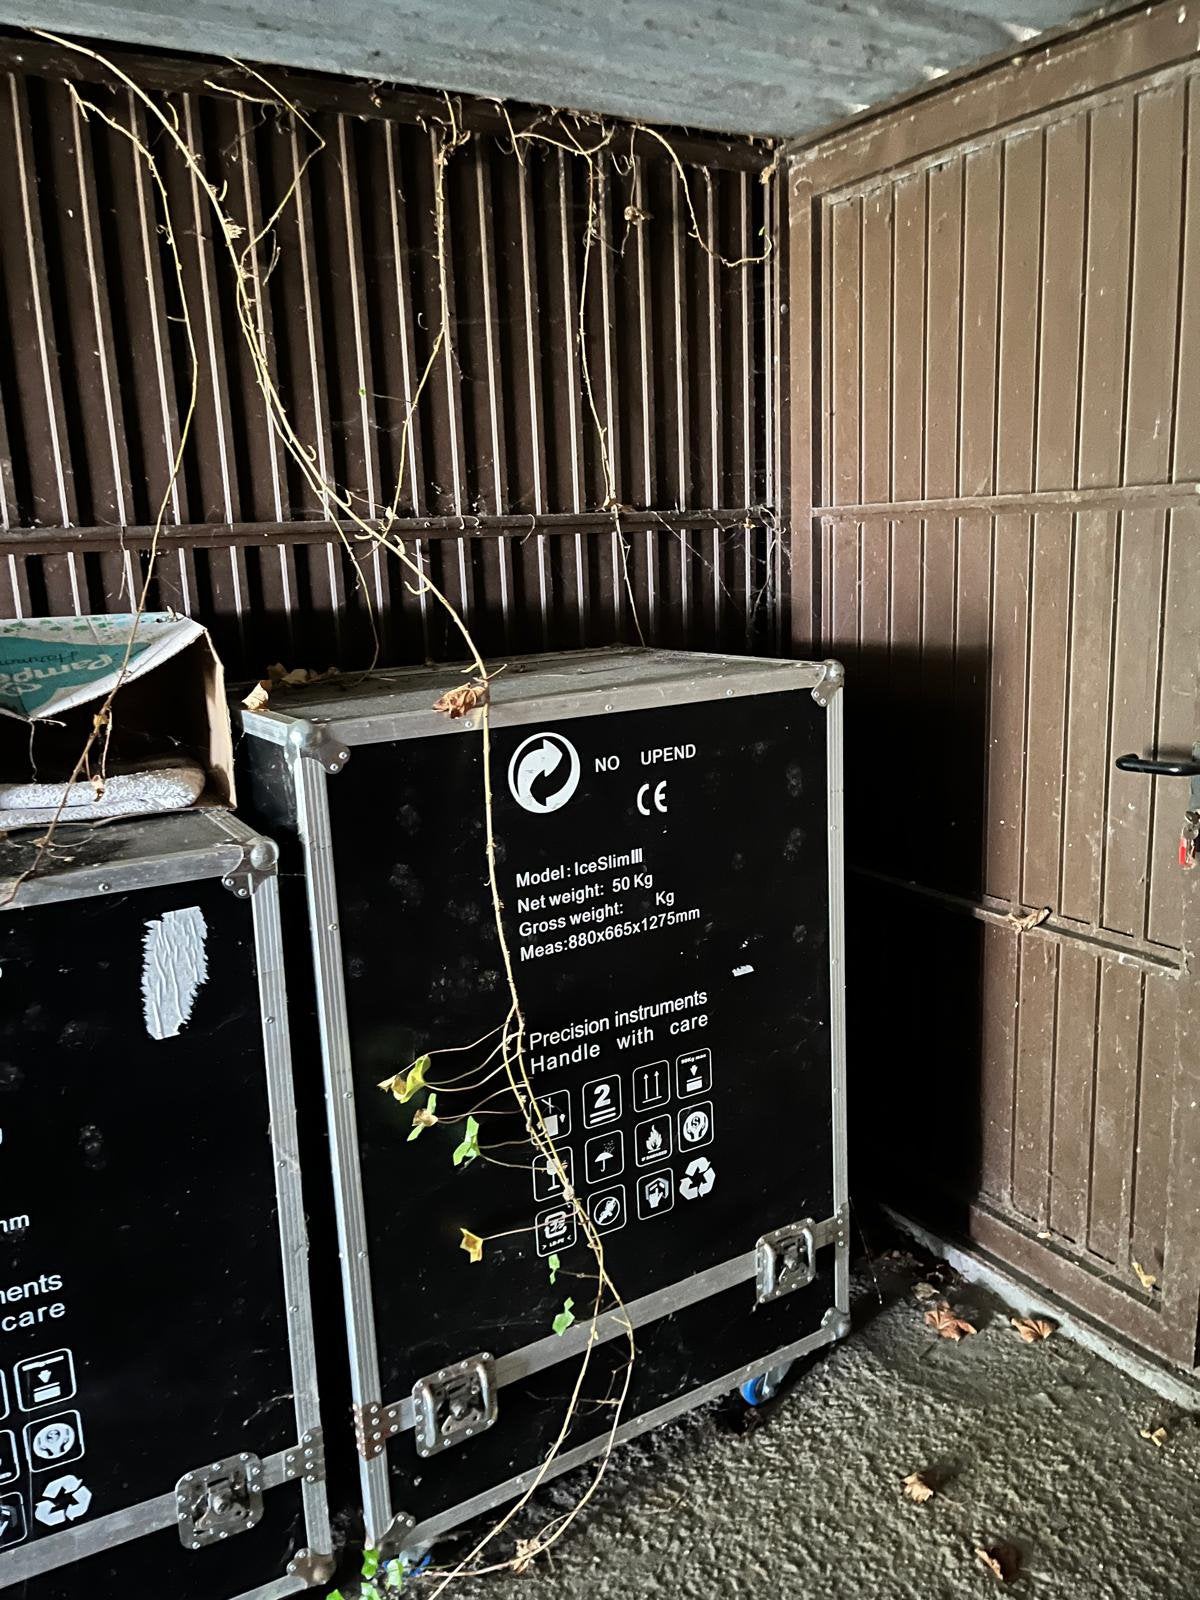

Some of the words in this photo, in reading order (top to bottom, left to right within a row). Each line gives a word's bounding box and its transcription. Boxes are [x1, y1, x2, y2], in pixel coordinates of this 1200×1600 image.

[594, 756, 621, 773] NO
[640, 744, 697, 766] UPEND
[636, 780, 669, 816] CE
[515, 860, 572, 888] Model:
[517, 893, 547, 914] Net
[548, 883, 605, 908] weight:
[612, 876, 631, 893] 50
[633, 872, 654, 889] Kg
[518, 916, 567, 937] Gross
[569, 901, 625, 926] weight:
[655, 890, 676, 907] Kg
[529, 1017, 610, 1051] Precision
[614, 990, 708, 1028] instruments
[530, 1041, 601, 1075] Handle
[616, 1026, 655, 1050] with
[669, 1013, 710, 1035] care
[593, 1083, 612, 1109] 2
[1, 1302, 66, 1332] care
